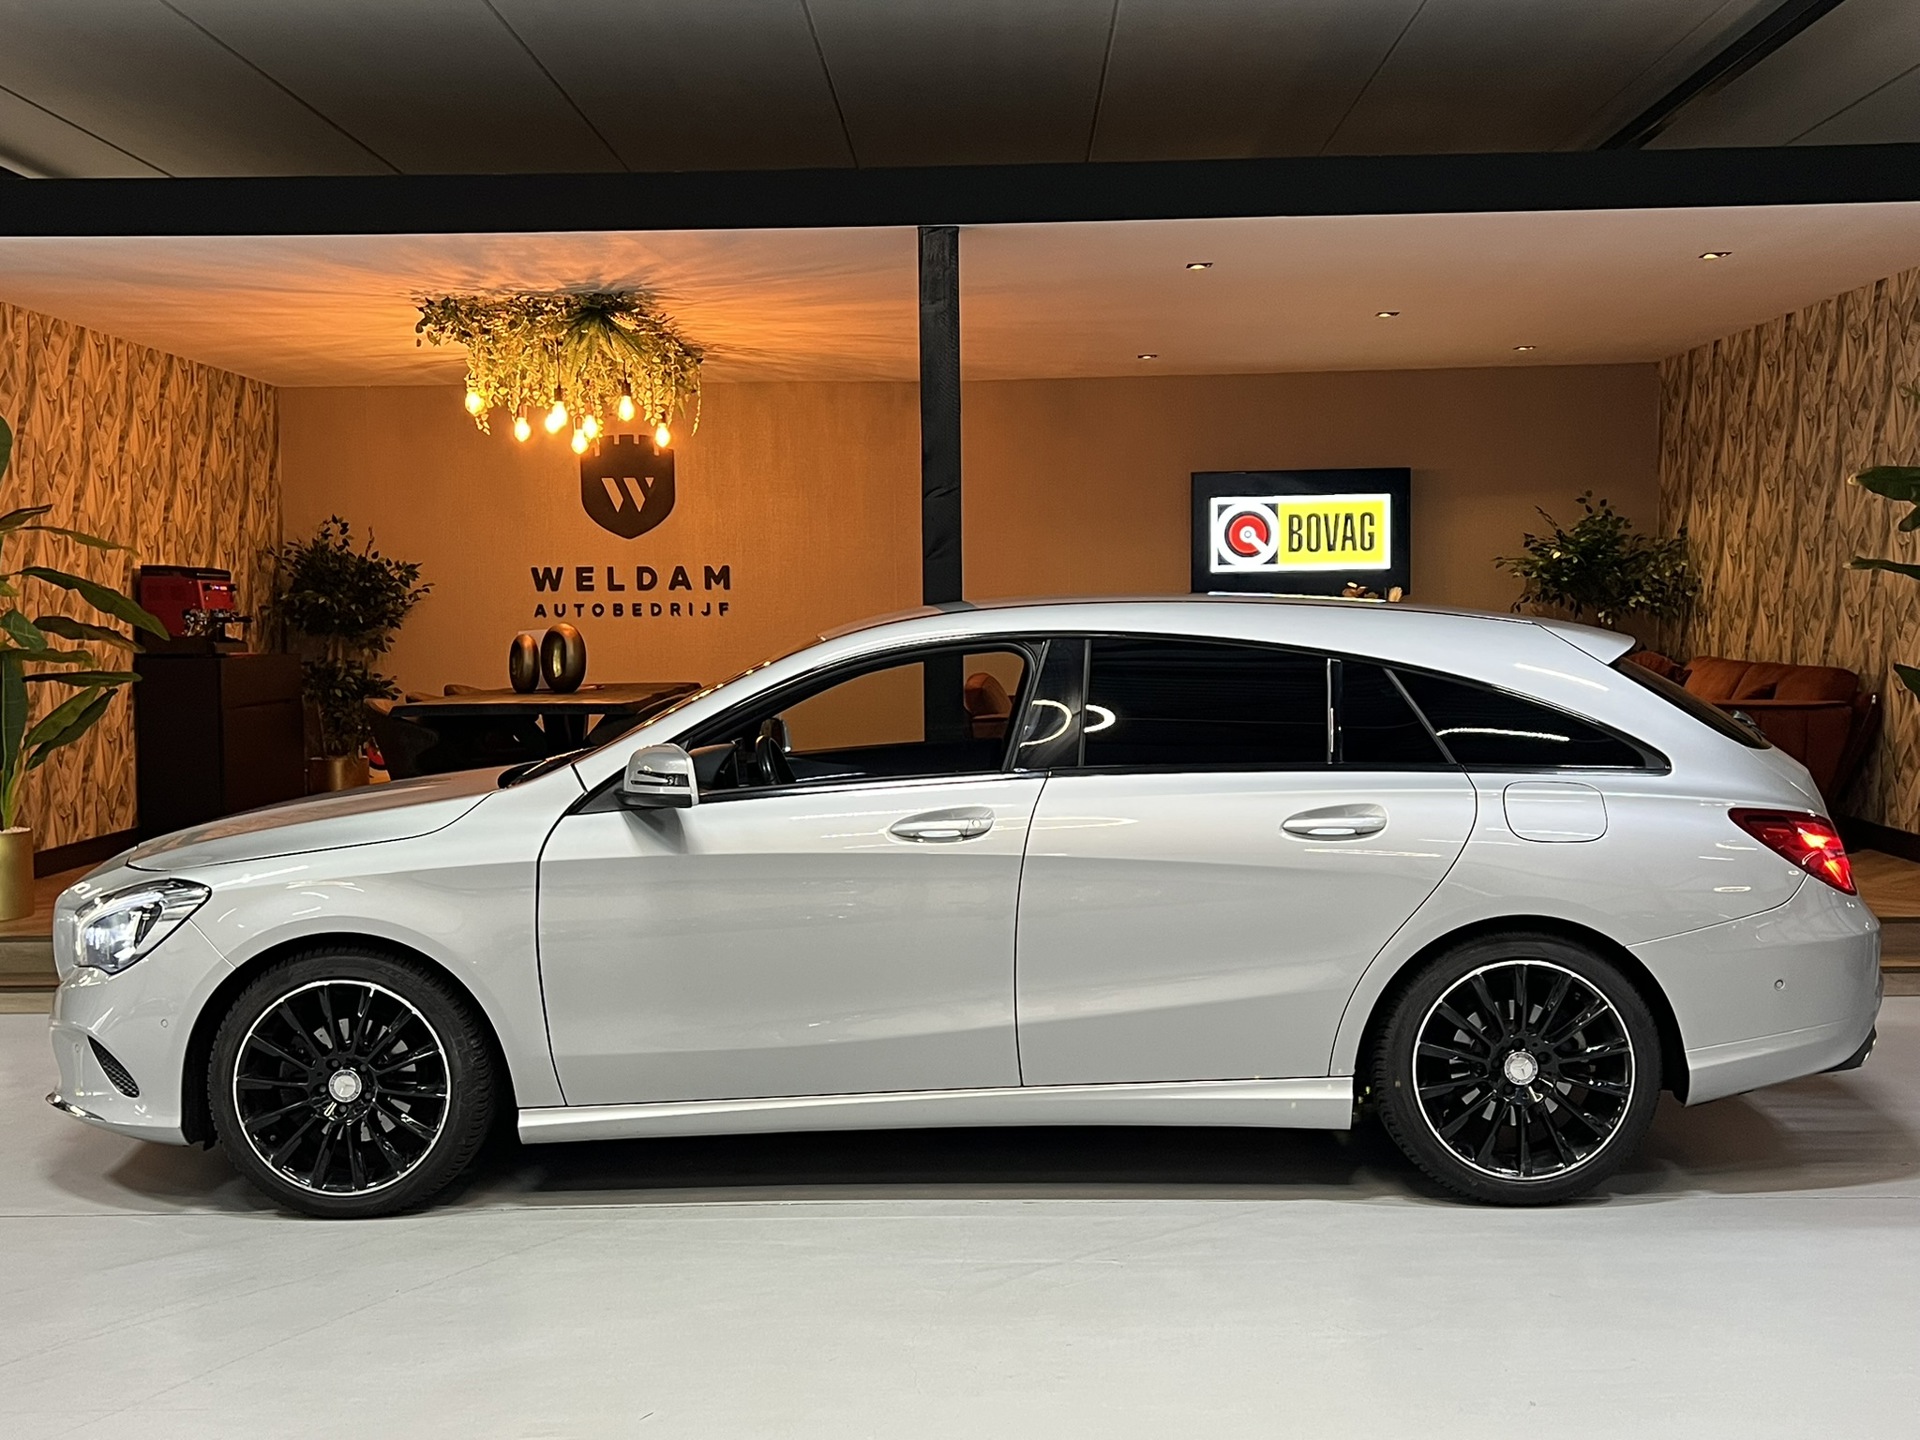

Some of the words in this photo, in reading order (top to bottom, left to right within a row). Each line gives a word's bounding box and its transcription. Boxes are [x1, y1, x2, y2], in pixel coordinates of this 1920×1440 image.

[1288, 512, 1375, 553] BOVAG
[530, 565, 731, 592] WELDAM
[533, 602, 730, 618] AUTOBEDRIJF
